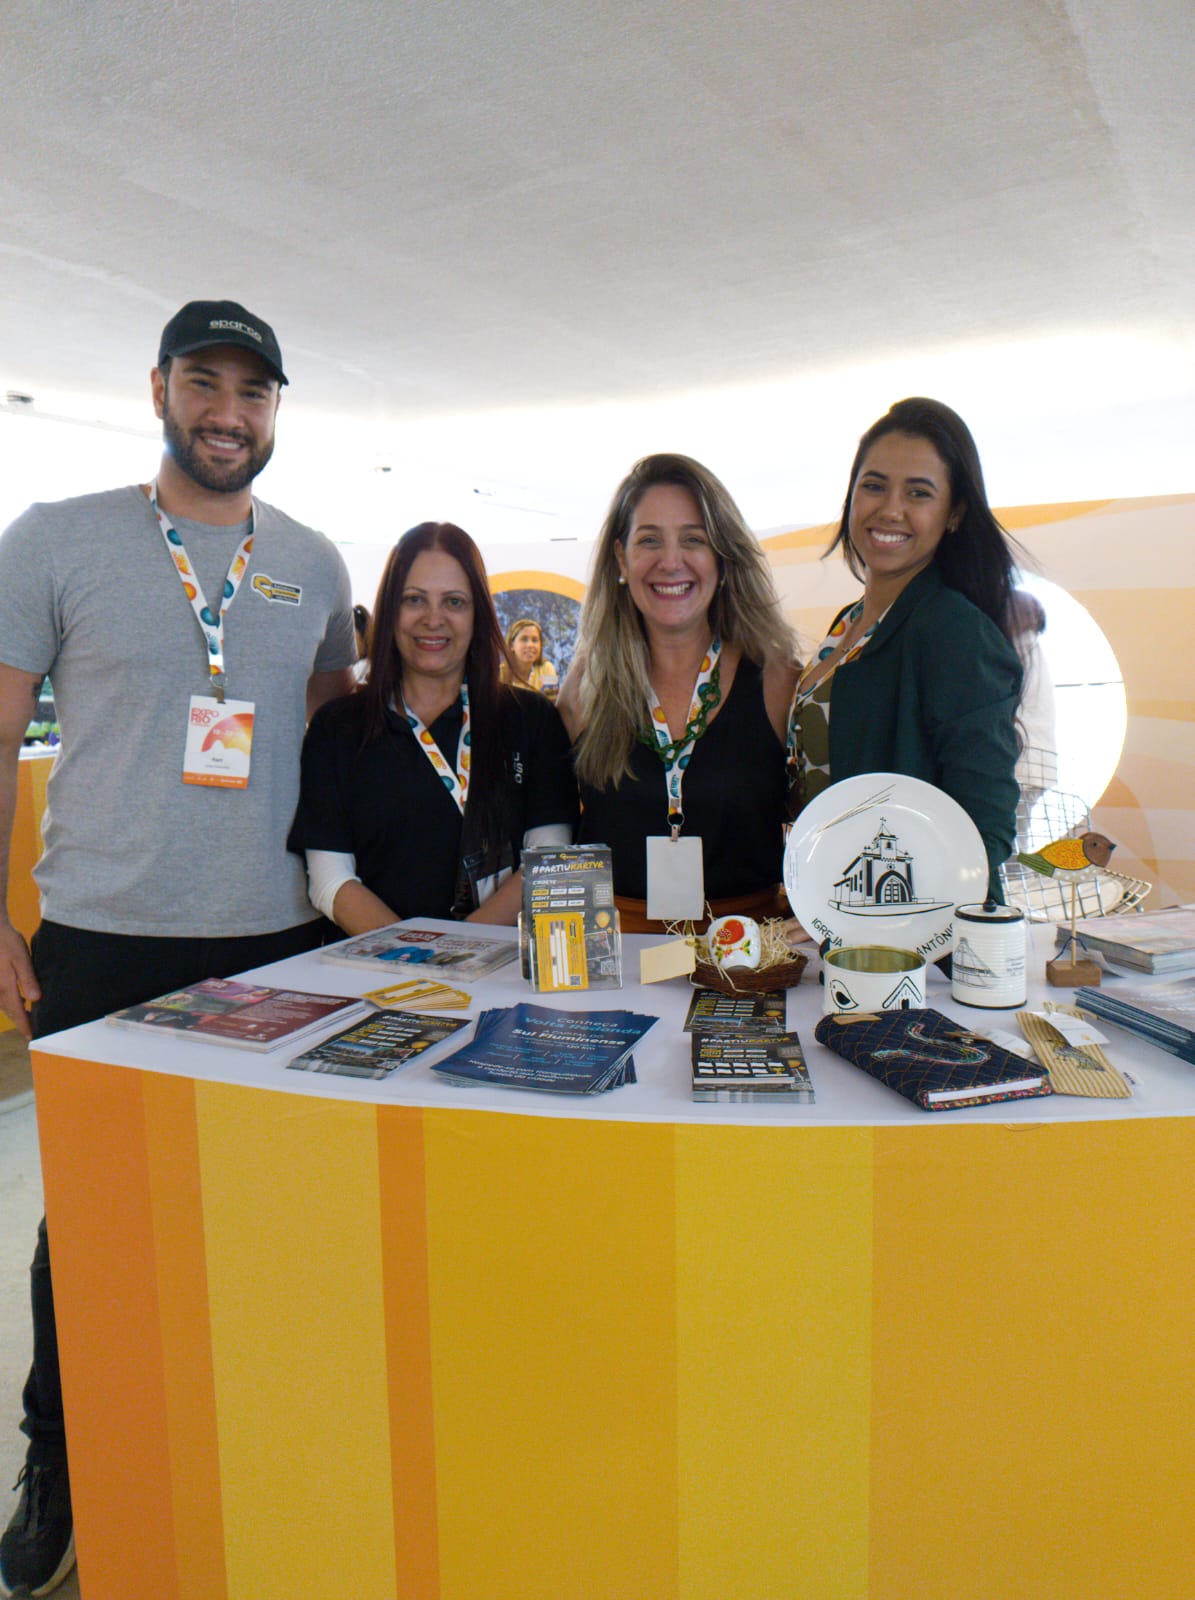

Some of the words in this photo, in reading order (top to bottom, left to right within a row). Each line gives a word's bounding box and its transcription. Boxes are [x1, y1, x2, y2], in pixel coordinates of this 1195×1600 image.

[191, 707, 220, 718] EXPO
[811, 917, 843, 947] IGREJA
[525, 1016, 565, 1028] Volta
[569, 1023, 641, 1035] Redonda
[557, 1017, 618, 1028] Conheça
[512, 1028, 538, 1037] Sul
[539, 1032, 627, 1046] Fluminense
